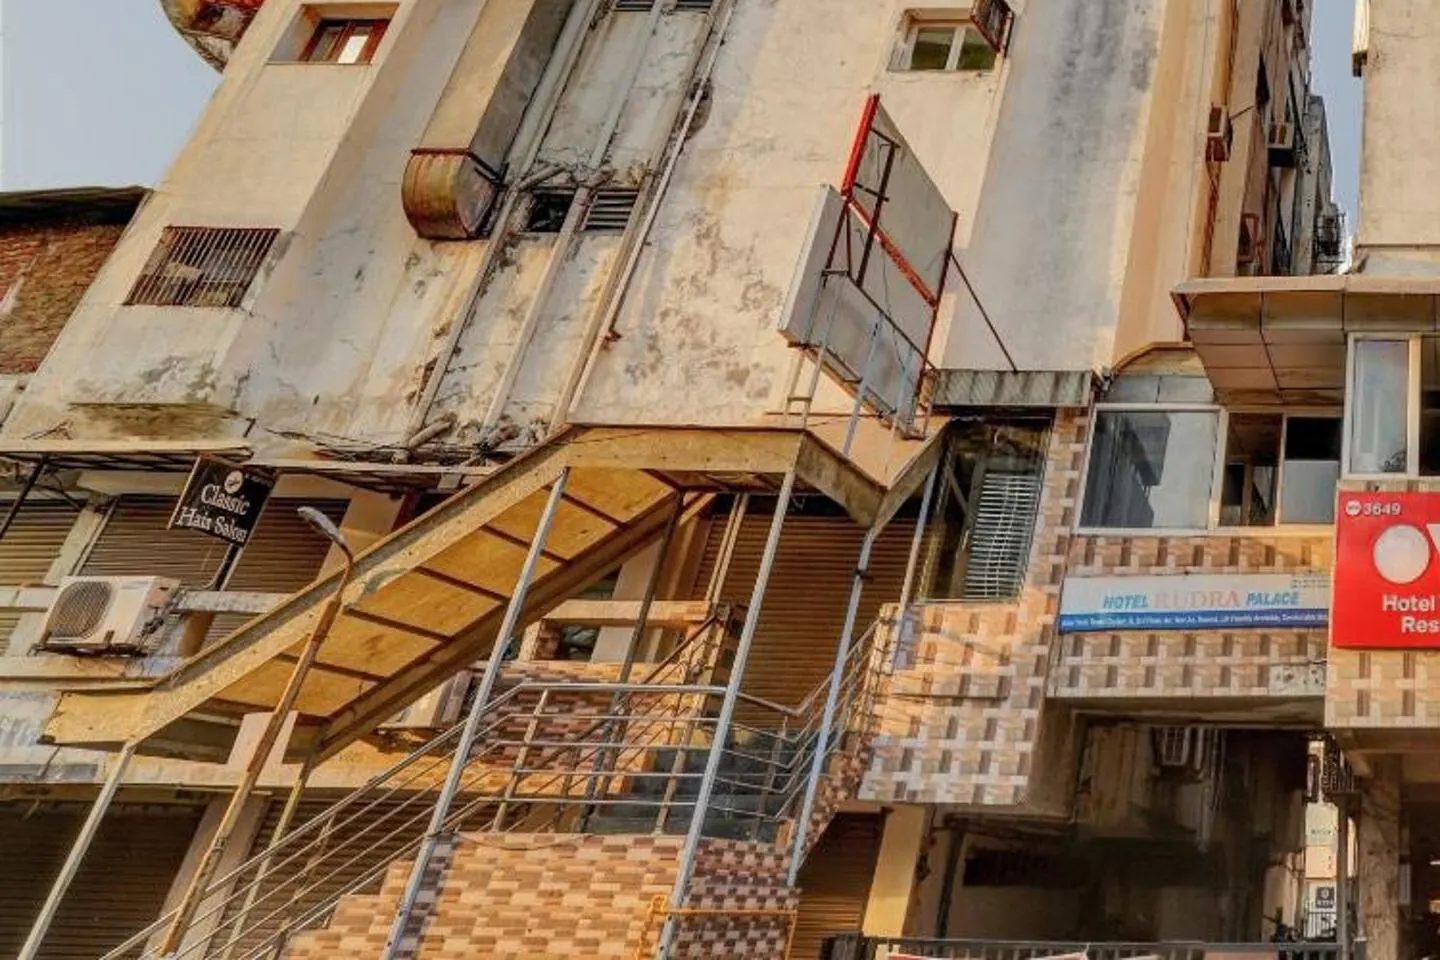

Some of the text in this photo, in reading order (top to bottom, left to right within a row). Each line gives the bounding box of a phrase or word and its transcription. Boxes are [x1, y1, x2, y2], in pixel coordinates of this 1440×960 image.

[201, 483, 250, 516] Classic
[1363, 502, 1401, 516] 3649
[175, 506, 248, 543] Hair Salon
[1103, 590, 1300, 609] HOTEL RUDRA PALACE
[1382, 594, 1436, 612] Hotel
